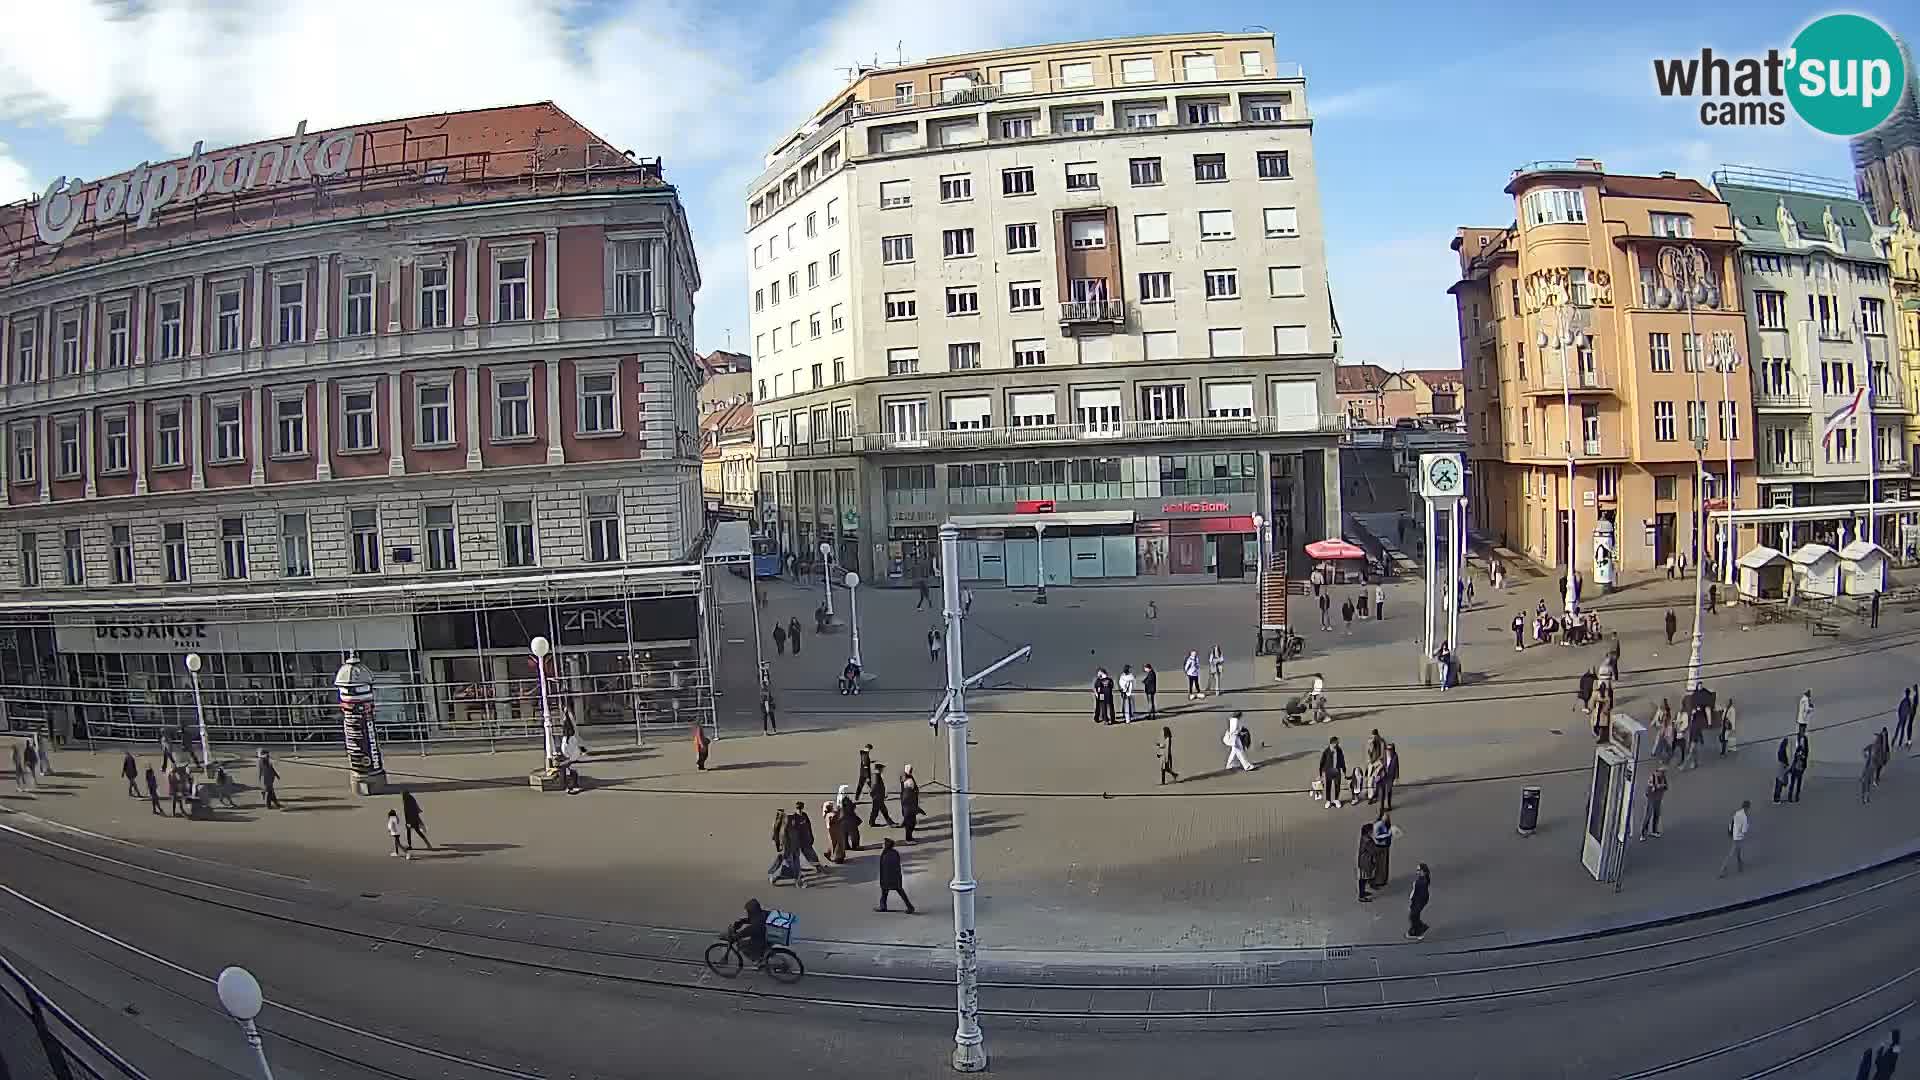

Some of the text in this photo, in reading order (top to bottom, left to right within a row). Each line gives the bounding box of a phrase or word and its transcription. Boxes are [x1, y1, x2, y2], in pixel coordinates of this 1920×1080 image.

[95, 119, 356, 229] otp banka
[95, 618, 207, 639] DESSANGE
